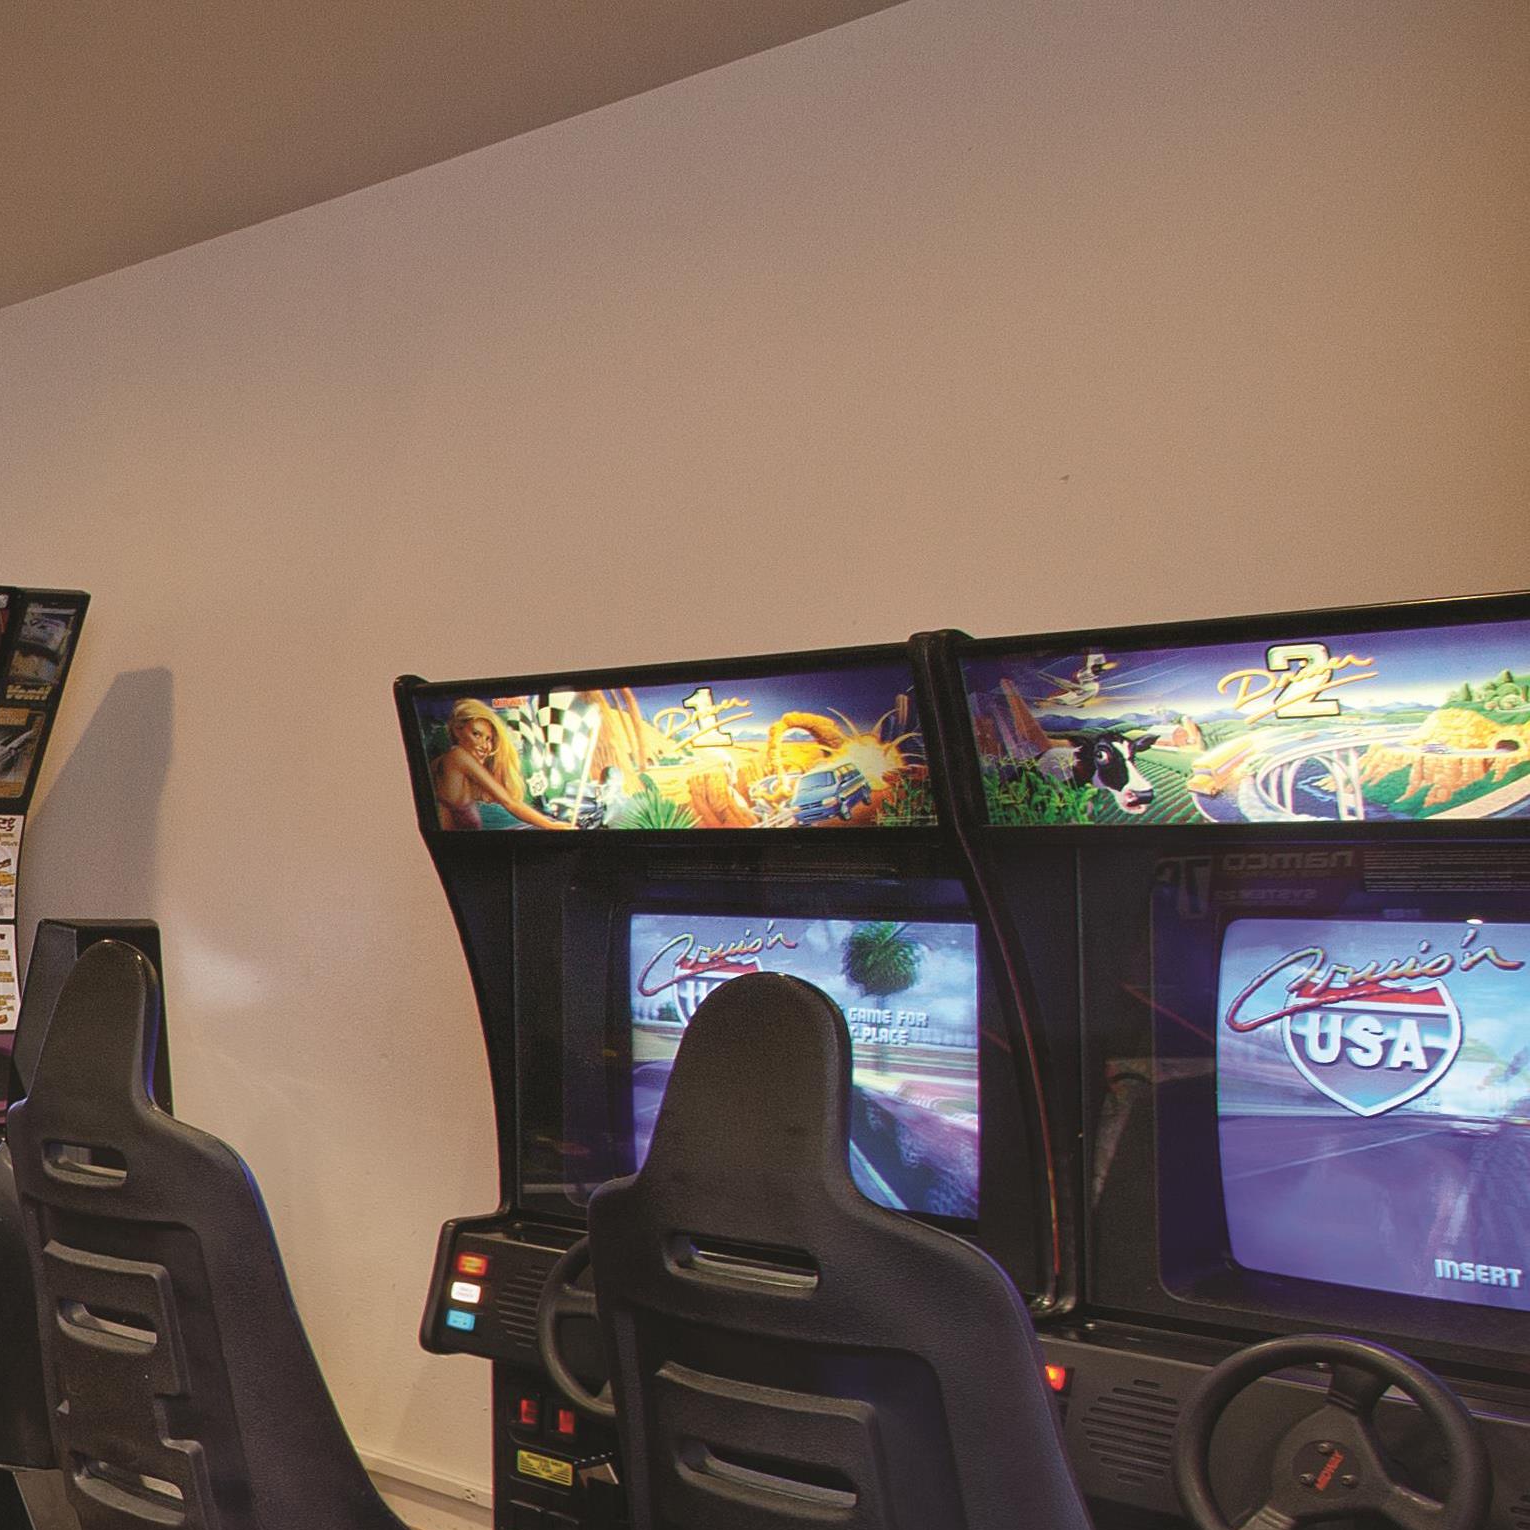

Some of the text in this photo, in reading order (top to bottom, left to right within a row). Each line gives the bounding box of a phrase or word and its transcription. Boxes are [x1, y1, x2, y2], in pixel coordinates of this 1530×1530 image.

[1264, 642, 1341, 720] 2
[681, 687, 732, 748] 1
[1225, 927, 1526, 1033] Cruis'n
[849, 1008, 929, 1028] GAME FOR
[862, 1026, 908, 1045] PLACE
[1307, 1011, 1429, 1071] USA
[1434, 1258, 1523, 1288] INSERT
